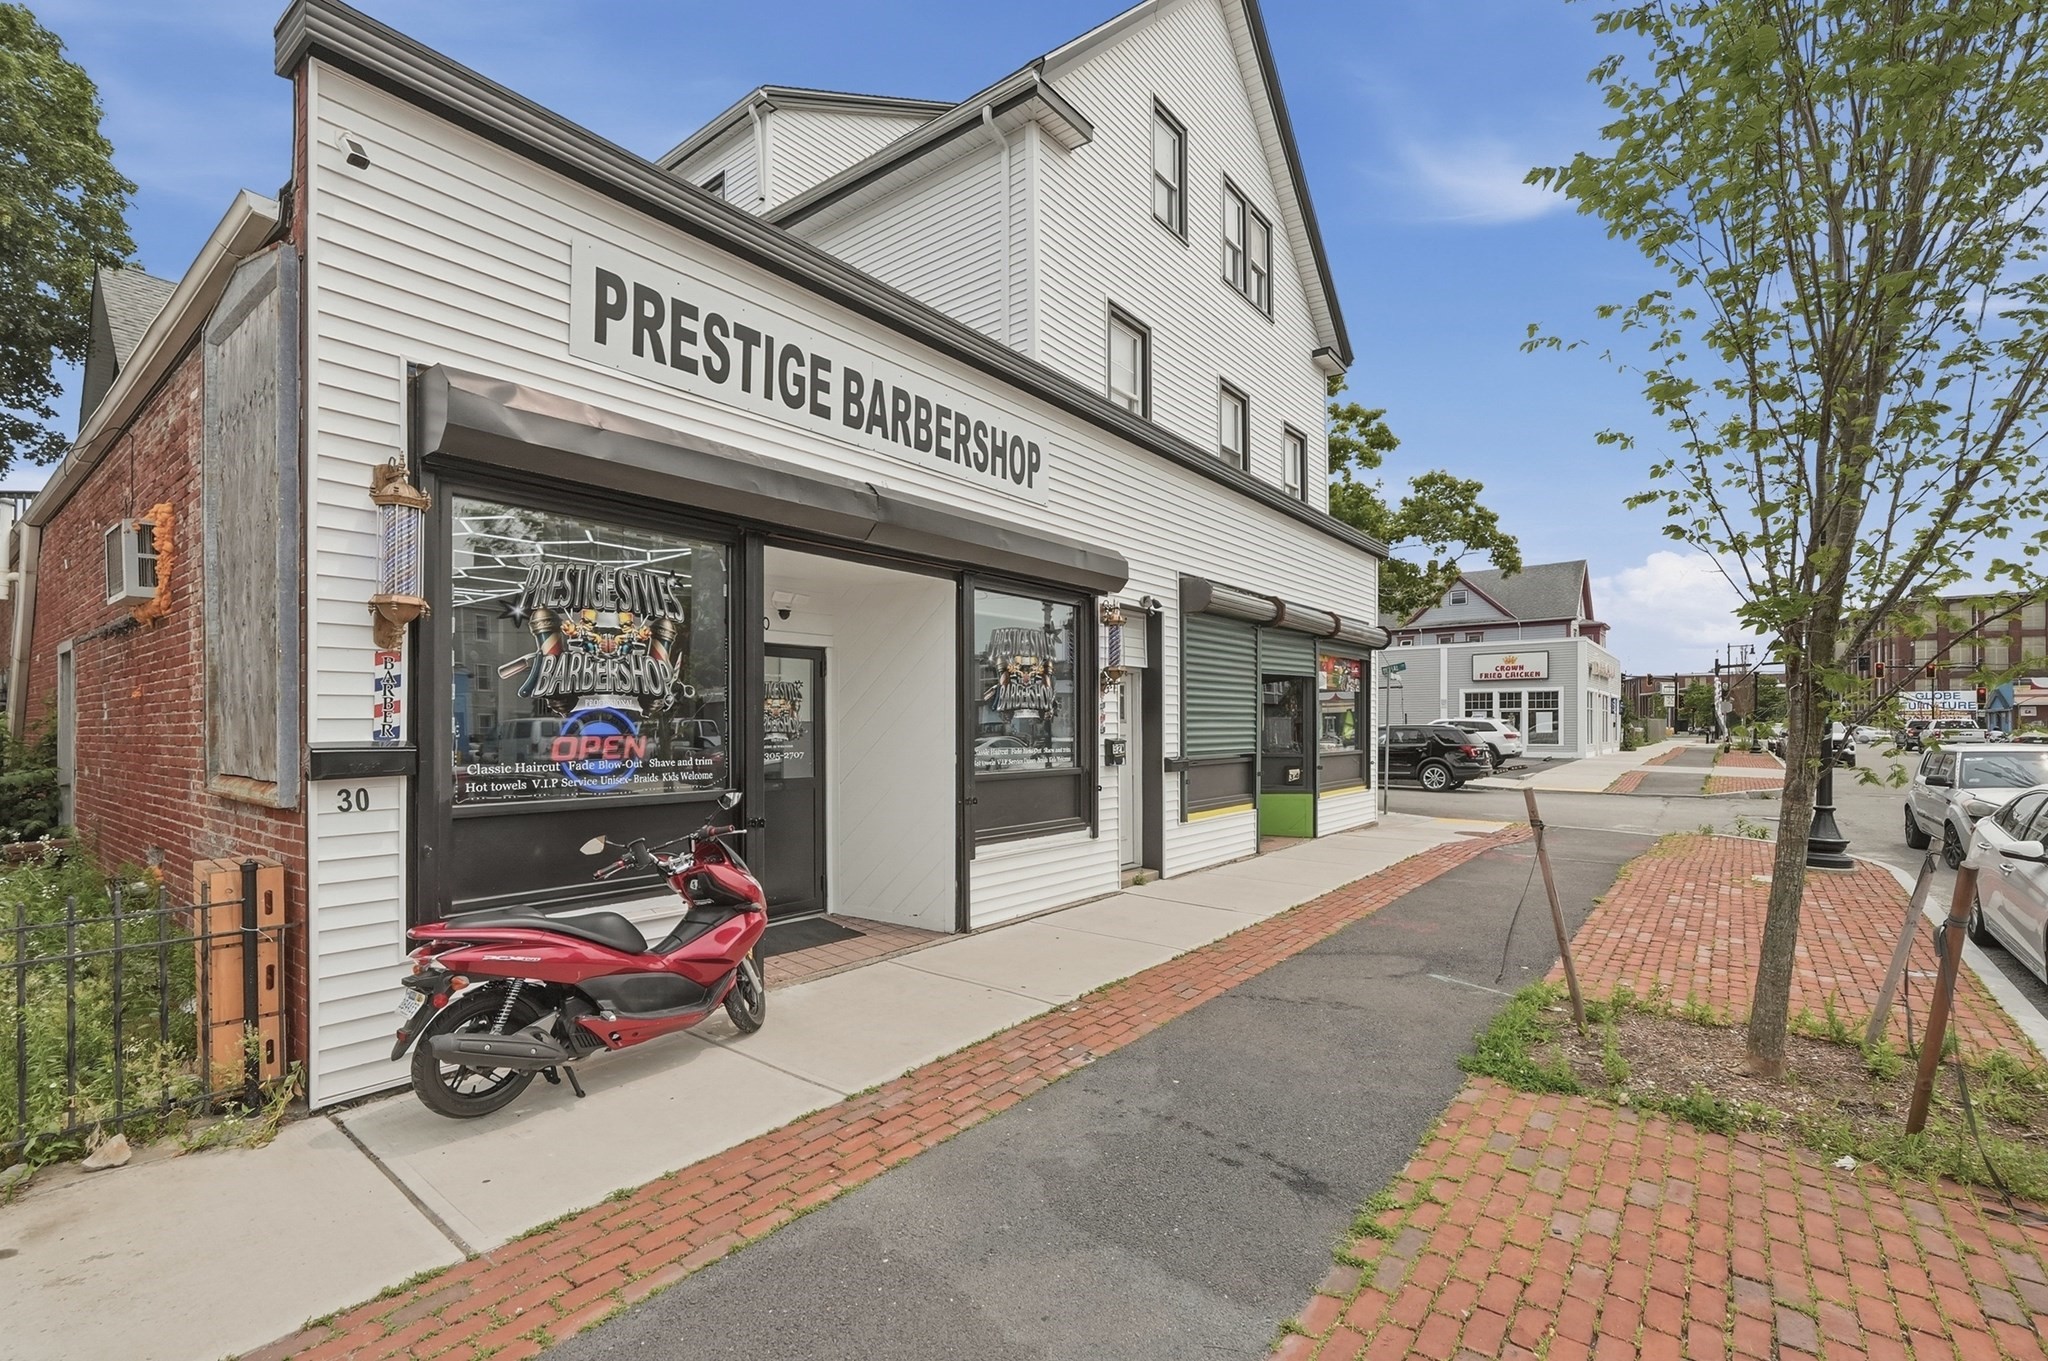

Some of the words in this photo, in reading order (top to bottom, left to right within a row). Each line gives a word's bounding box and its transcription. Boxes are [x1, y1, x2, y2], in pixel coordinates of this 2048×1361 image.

[594, 266, 832, 421] PRESTIGE
[842, 366, 1041, 489] BARBERSHOP
[519, 561, 618, 612] PRESTIGE
[615, 568, 685, 624] STYLES
[531, 651, 675, 699] BARBERSHOP
[1494, 664, 1525, 672] CROWN
[1504, 671, 1541, 679] CHICKEN
[381, 656, 397, 738] BARBER
[1901, 701, 1976, 710] FURNTURE
[1915, 692, 1961, 700] GLOBE
[551, 735, 647, 762] OPEN
[466, 763, 512, 776] Classic
[515, 762, 560, 773] Haircut
[568, 760, 595, 770] Fade
[598, 759, 643, 770] Blow-Out
[649, 758, 676, 768] Shave
[677, 757, 693, 766] and
[695, 757, 713, 766] trim
[465, 782, 488, 793] Hot
[491, 780, 527, 792] towels
[532, 779, 559, 789] V.I.P
[561, 777, 598, 788] Service
[634, 773, 659, 783] Braids
[662, 772, 679, 782] Kids
[680, 770, 714, 781] Welcome
[336, 787, 370, 813] 30
